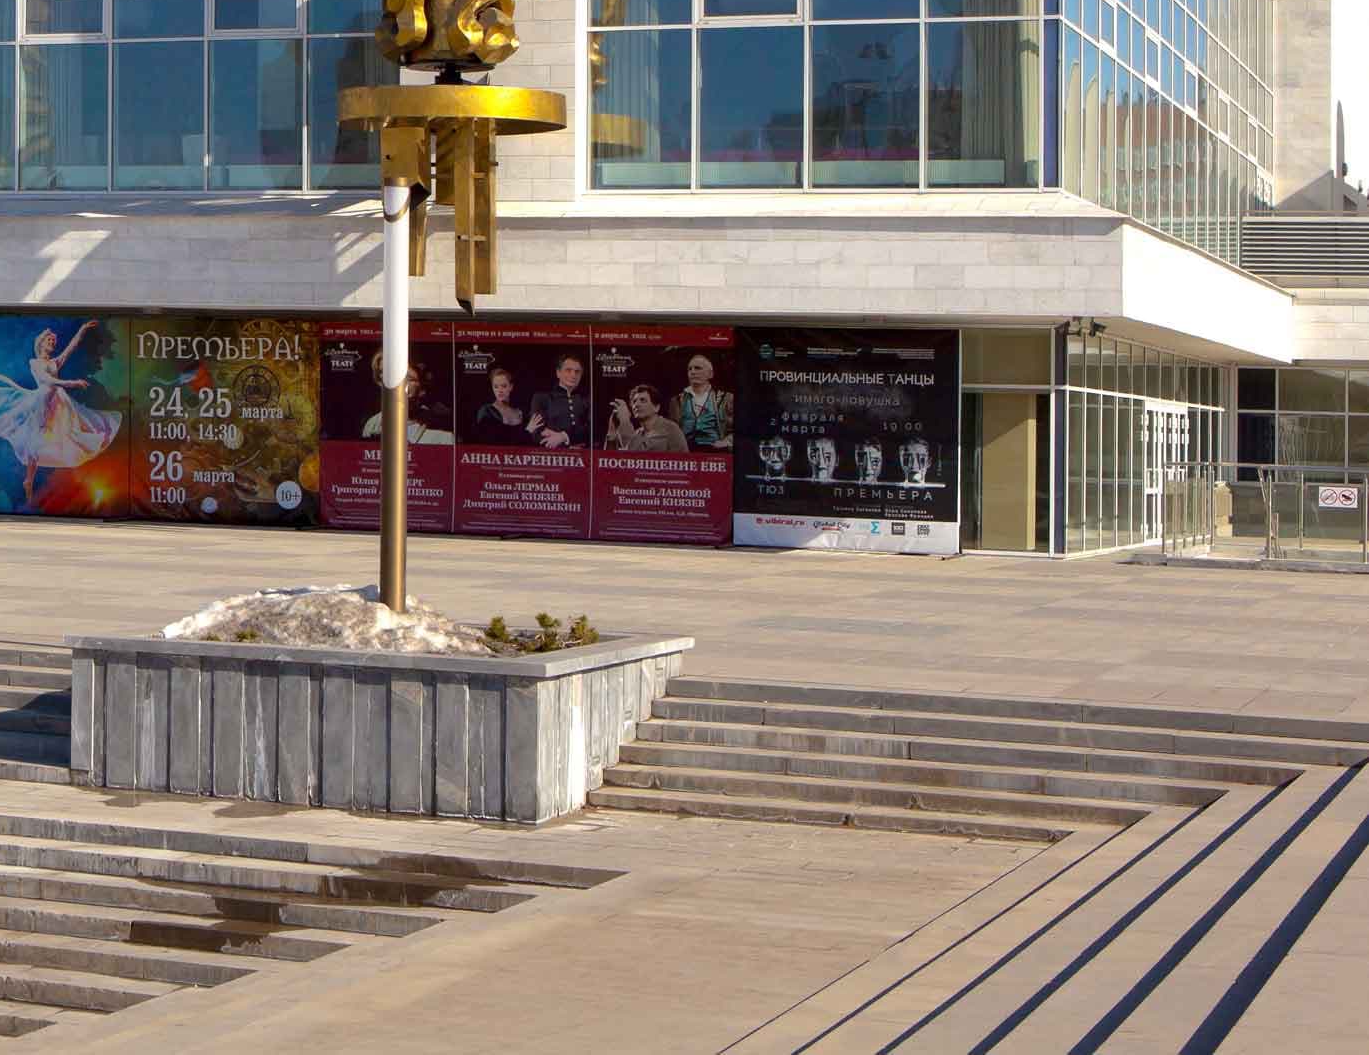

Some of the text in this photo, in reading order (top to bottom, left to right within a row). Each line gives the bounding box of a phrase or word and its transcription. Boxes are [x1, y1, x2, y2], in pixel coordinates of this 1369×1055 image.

[136, 331, 301, 360] ПРЕМЬЕРА!
[759, 370, 935, 387] ПРОВИНЦИАЛЬНЫЕ ТАНЦЫ
[149, 386, 284, 421] 24, 25 марта
[149, 422, 238, 442] 11:00, 14:30
[461, 452, 585, 468] АННА КАРЕНИНА
[599, 458, 727, 473] ПОСВЯЩЕНИЕ ЕВЕ
[149, 450, 236, 487] 26 марта
[351, 476, 379, 486] Юлия
[484, 481, 560, 493] Ольга ЛЕРМАН
[149, 487, 186, 504] 11:00
[331, 484, 377, 496] Григорий
[479, 490, 565, 503] Евгений КНЯЗЕВ
[612, 485, 711, 499] Василий ЛАНОВОЙ
[758, 484, 933, 501] ТЮЗ ПРЕМЬЕРА
[462, 499, 507, 510] Дмитрий
[618, 495, 706, 508] Евгений КНЯЗЕВ
